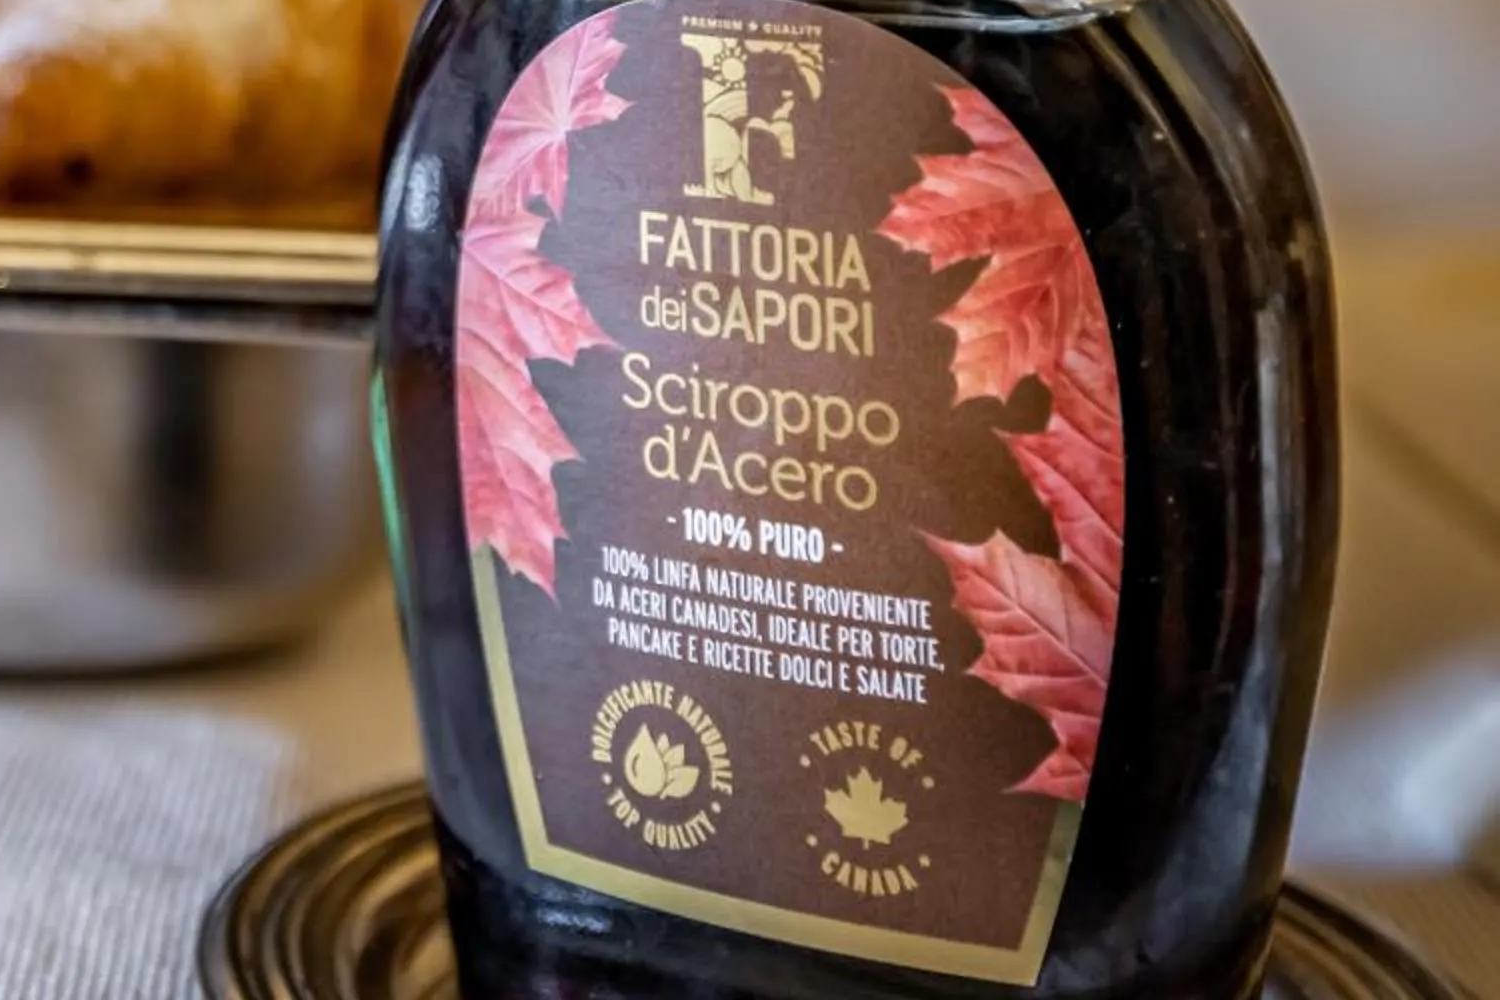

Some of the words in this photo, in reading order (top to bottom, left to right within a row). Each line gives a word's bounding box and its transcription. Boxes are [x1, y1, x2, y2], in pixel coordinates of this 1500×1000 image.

[681, 15, 743, 31] PREMIUM
[763, 22, 823, 36] QUALITY
[639, 210, 871, 292] FATTORIA
[622, 352, 900, 452] Sciroppo
[643, 424, 878, 511] d'Acero
[682, 507, 752, 550] 100%
[759, 519, 825, 563] PURO
[593, 578, 615, 609] DA
[620, 585, 667, 621] ACERI
[672, 597, 763, 641] CANADESI,
[769, 615, 831, 652] IDEALE
[837, 627, 874, 658] PER
[880, 632, 945, 672] TORTE,
[602, 546, 649, 581] 100%
[653, 557, 701, 592] LINFA
[706, 567, 797, 609] NATURALE
[803, 584, 933, 630] PROVENIENTE
[608, 617, 682, 660] PANCAKE
[687, 635, 699, 664] E
[703, 640, 775, 679] RICETTE
[779, 655, 833, 690] DOLCI
[840, 666, 851, 692] E
[856, 666, 928, 704] SALATE
[591, 679, 675, 764] DOLCIFICANTE
[677, 694, 734, 797] NATURALE
[810, 720, 882, 757] TASTE
[889, 736, 925, 769] OF
[606, 788, 641, 828] TOP
[643, 808, 717, 850] QUALITY
[821, 851, 919, 898] CANADA
